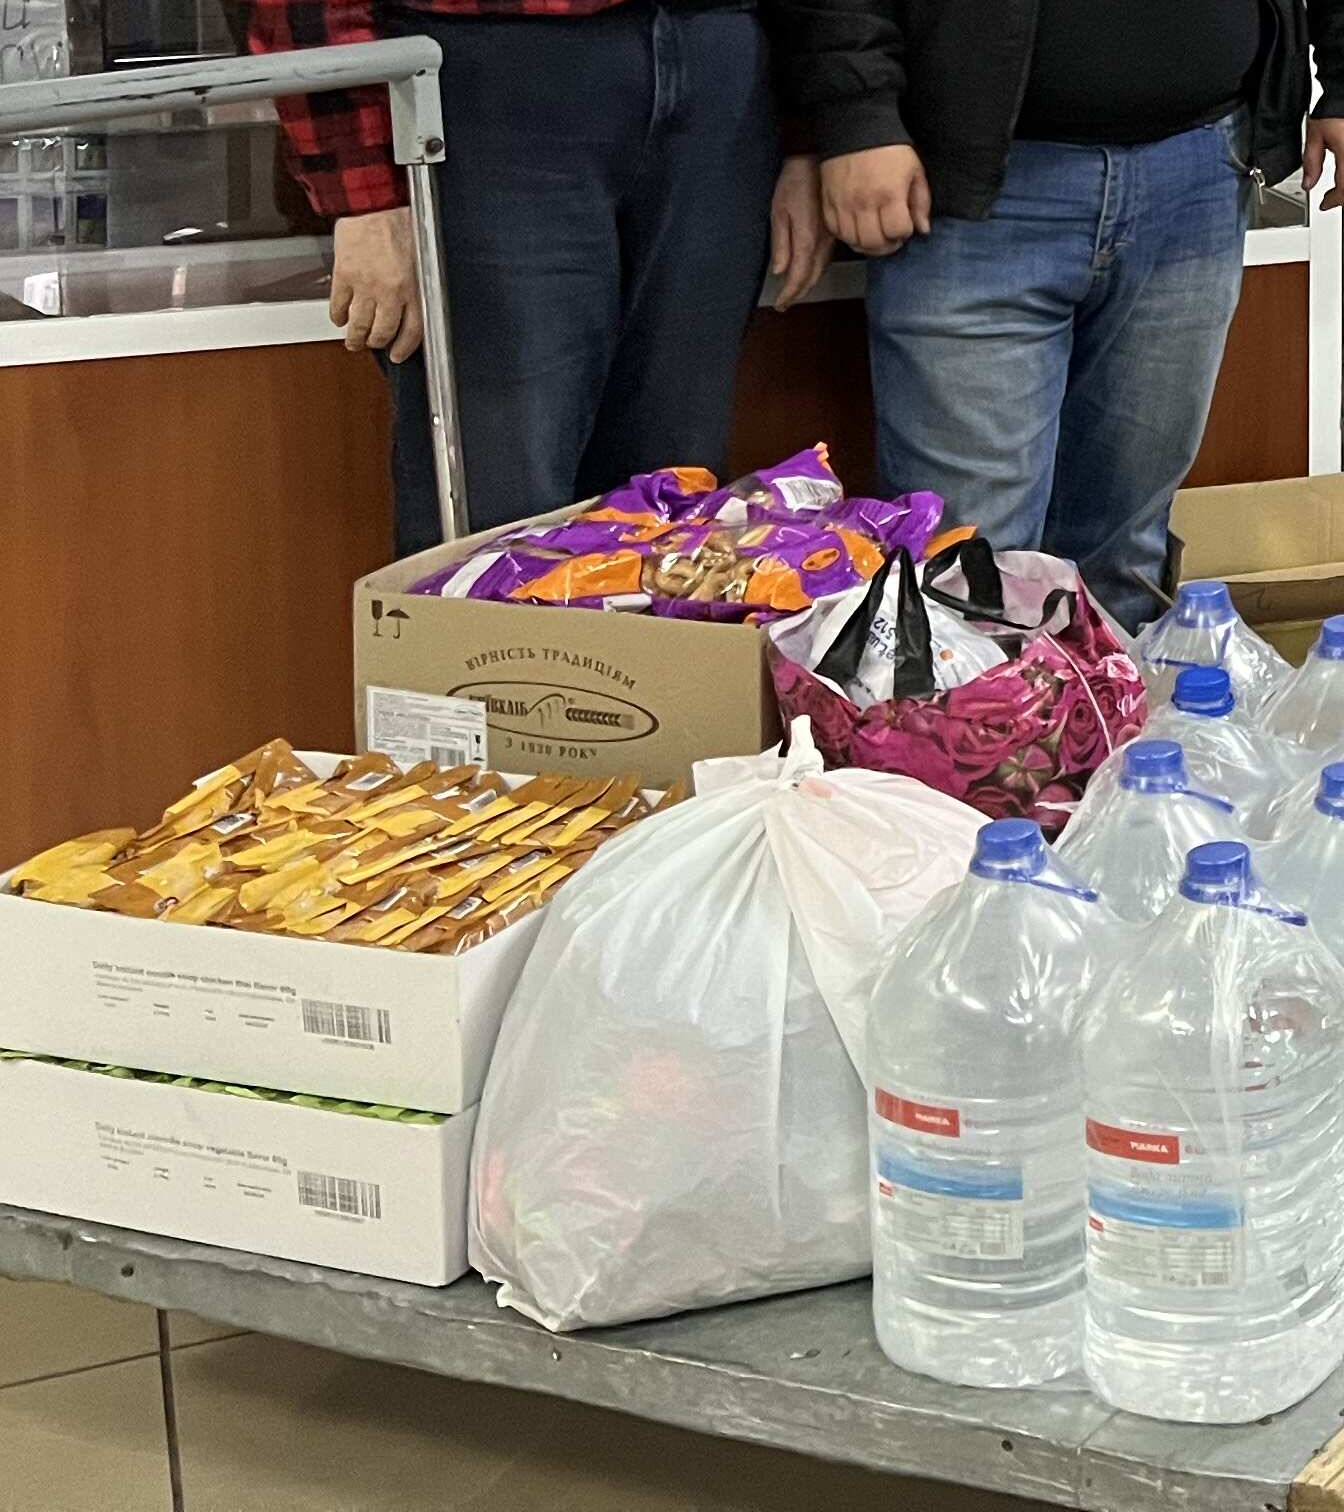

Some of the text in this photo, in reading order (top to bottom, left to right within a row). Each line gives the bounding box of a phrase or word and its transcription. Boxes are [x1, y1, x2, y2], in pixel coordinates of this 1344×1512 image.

[464, 647, 637, 690] ВІРНІСТЬ ТРАДИЦІЯМ
[559, 745, 598, 759] РОКУ
